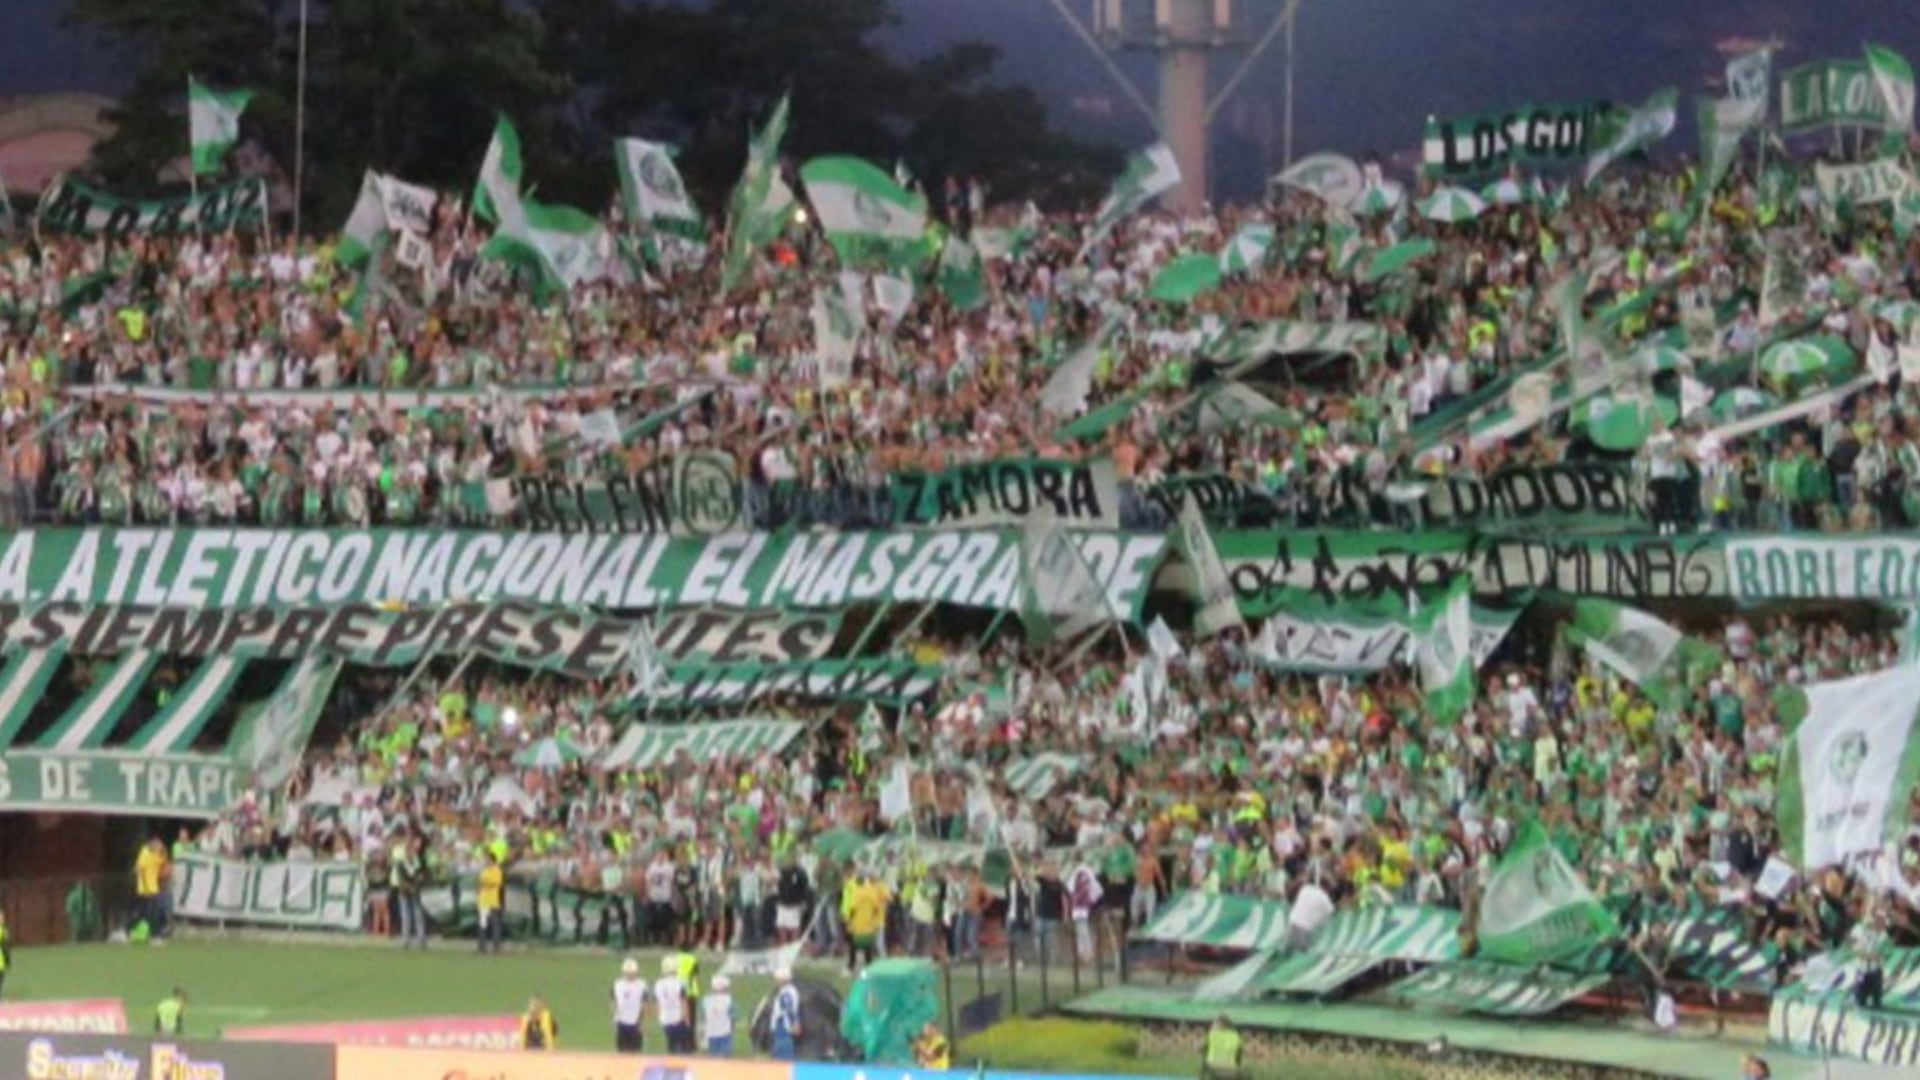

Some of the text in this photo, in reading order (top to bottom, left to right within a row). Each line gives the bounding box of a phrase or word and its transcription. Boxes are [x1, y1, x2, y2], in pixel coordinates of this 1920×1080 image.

[899, 464, 1103, 522] ZAMORA
[50, 528, 373, 606] ATLETICO
[678, 530, 769, 607] EL
[20, 600, 386, 659] SIEMPRE
[40, 758, 92, 801] DE
[174, 857, 357, 920] TULUA
